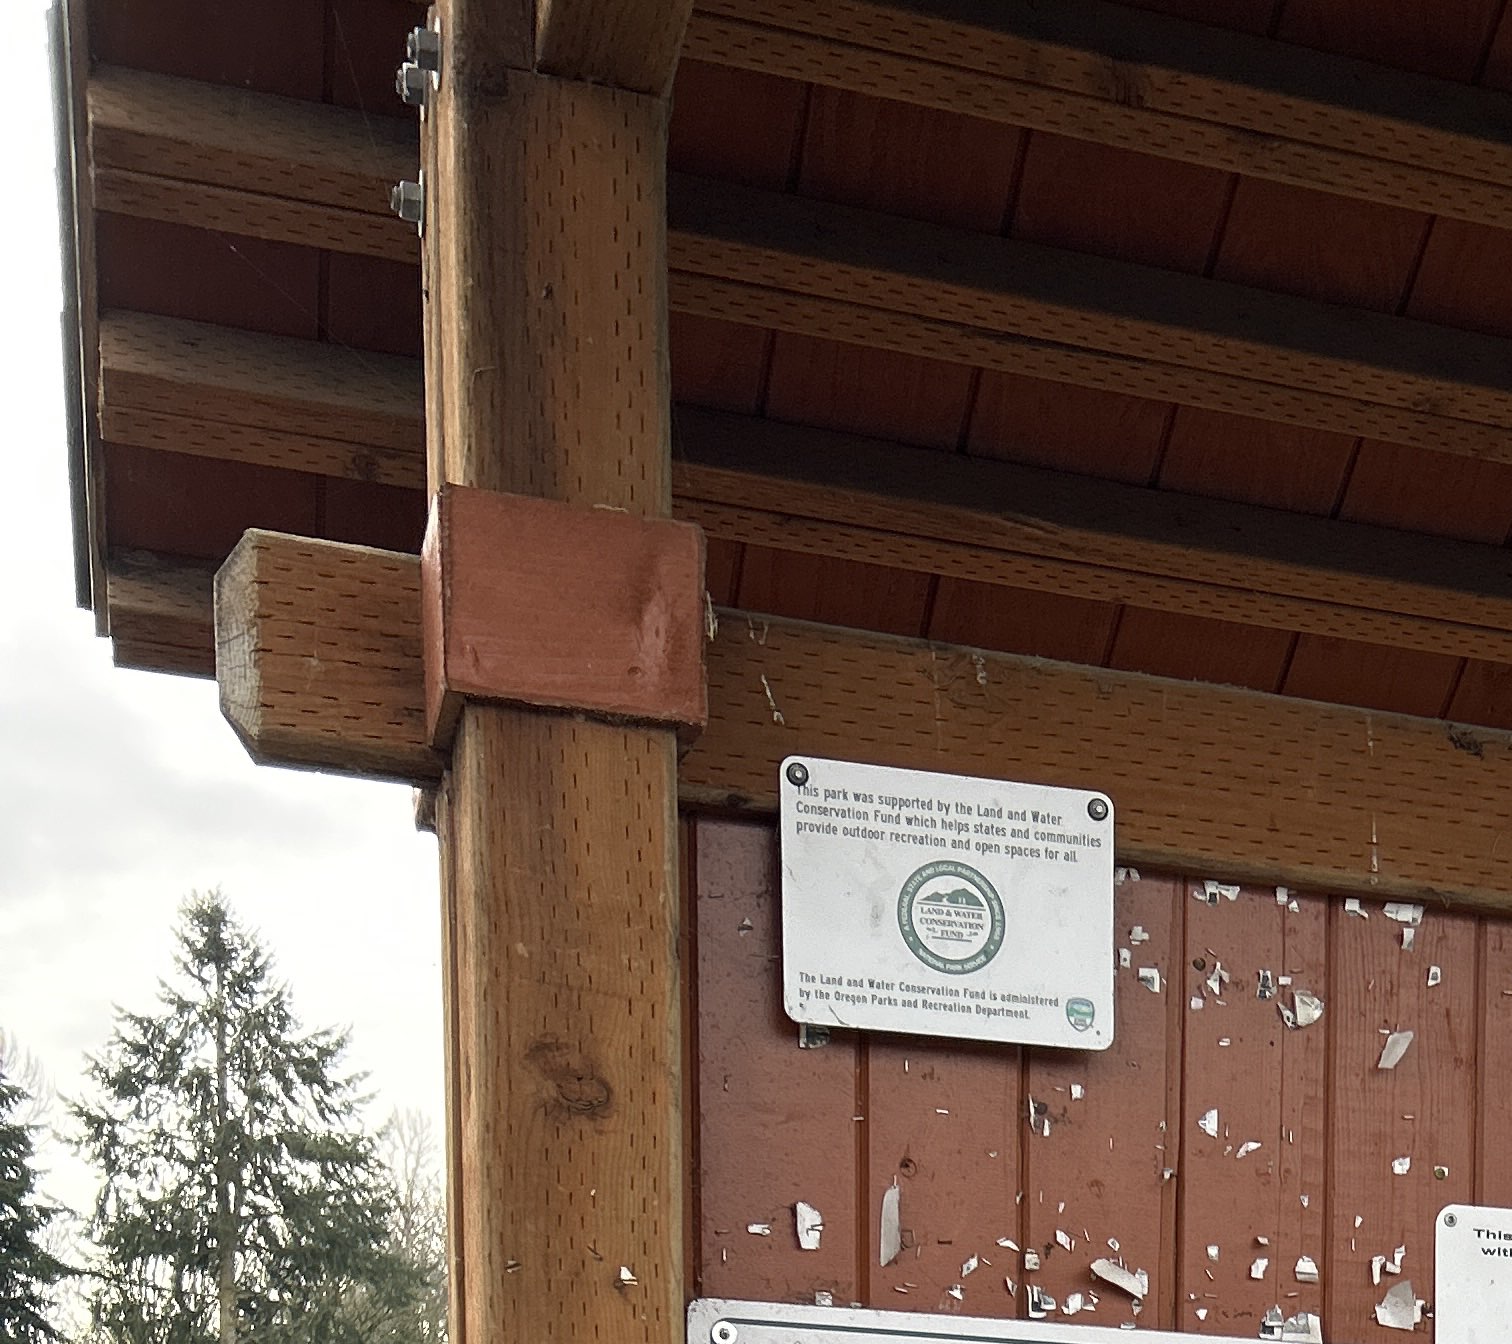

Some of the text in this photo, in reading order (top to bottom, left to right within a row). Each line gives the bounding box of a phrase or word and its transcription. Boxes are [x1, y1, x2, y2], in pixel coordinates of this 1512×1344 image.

[796, 784, 1062, 825] This park was supported by the Land and Water
[796, 800, 1102, 848] Conservation Fund which helps states and communities
[796, 821, 837, 835] provide
[842, 826, 885, 840] outdoor
[890, 832, 946, 847] recreation
[951, 838, 970, 850] and
[975, 842, 1000, 855] open
[1004, 845, 1040, 858] spaces
[1044, 847, 1059, 860] for
[1473, 1228, 1512, 1242] This
